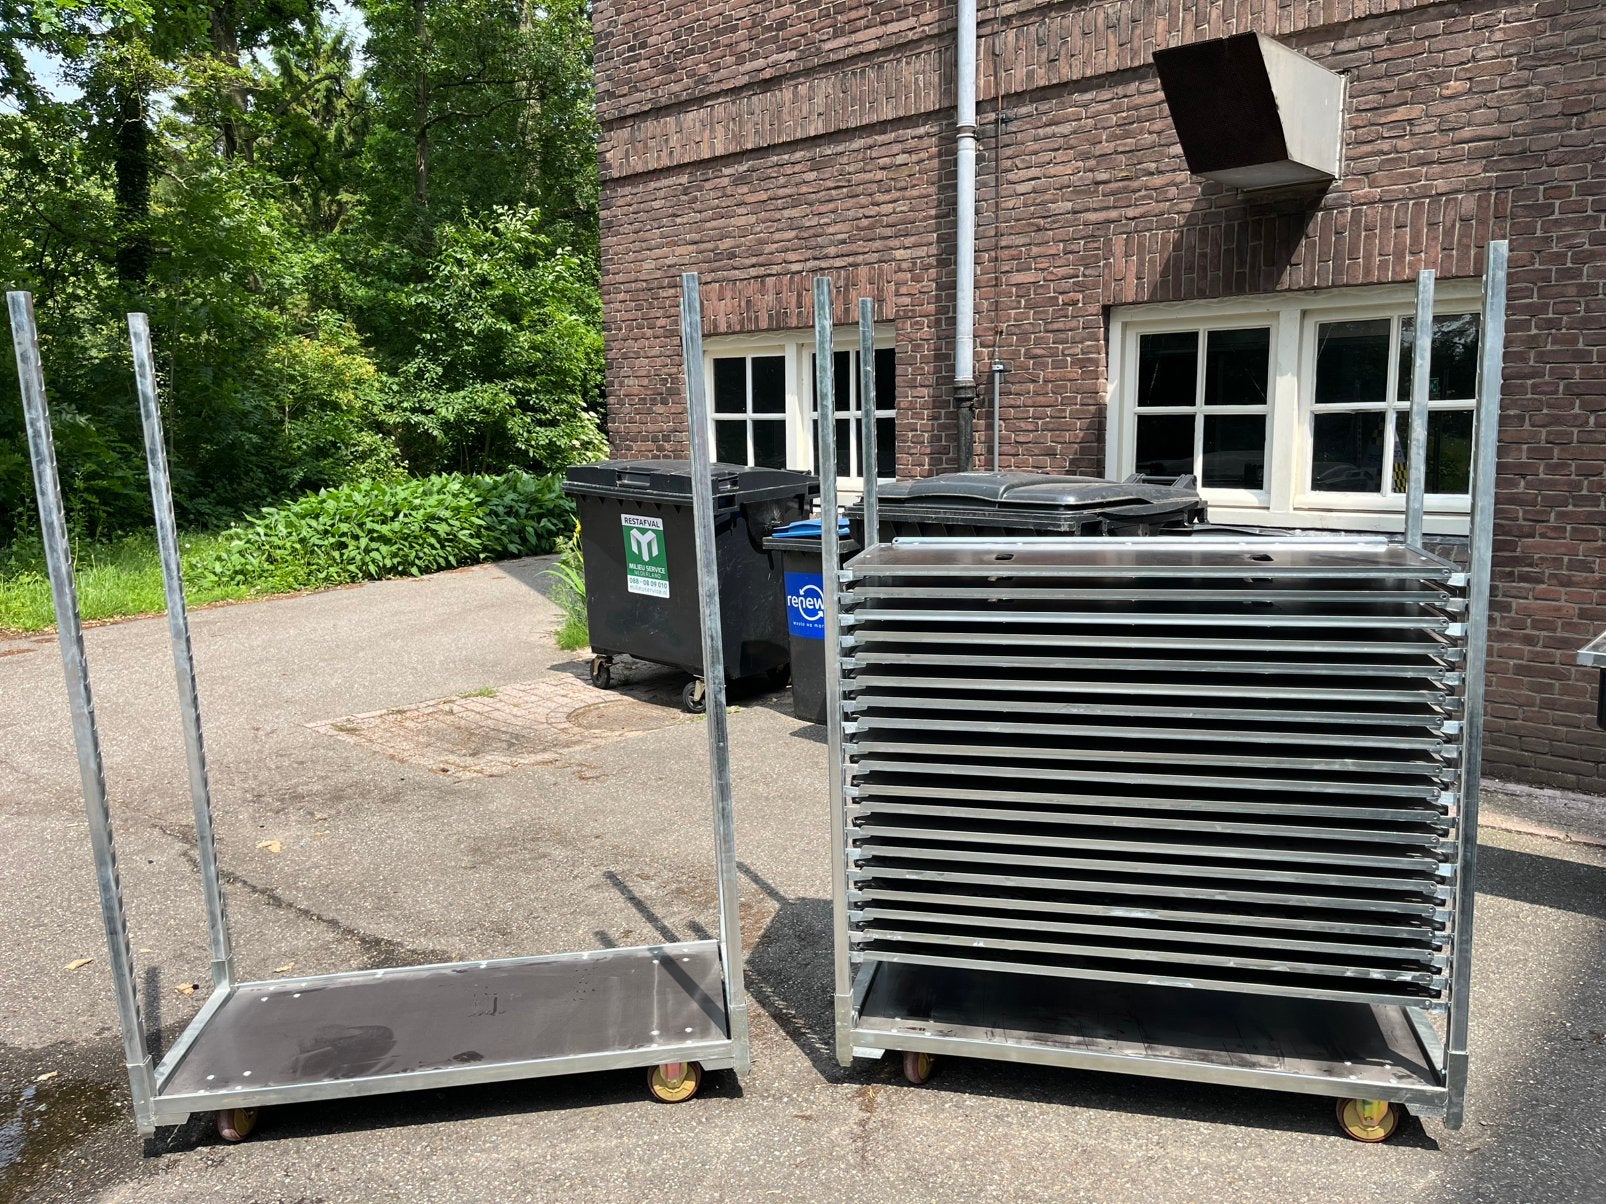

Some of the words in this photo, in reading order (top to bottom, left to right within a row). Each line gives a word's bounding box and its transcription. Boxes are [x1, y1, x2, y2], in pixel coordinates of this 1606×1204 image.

[624, 517, 660, 528] RESTAFVAL
[629, 563, 645, 571] MILIEU
[646, 565, 665, 574] SERVICE
[634, 570, 662, 579] NEDERLAND
